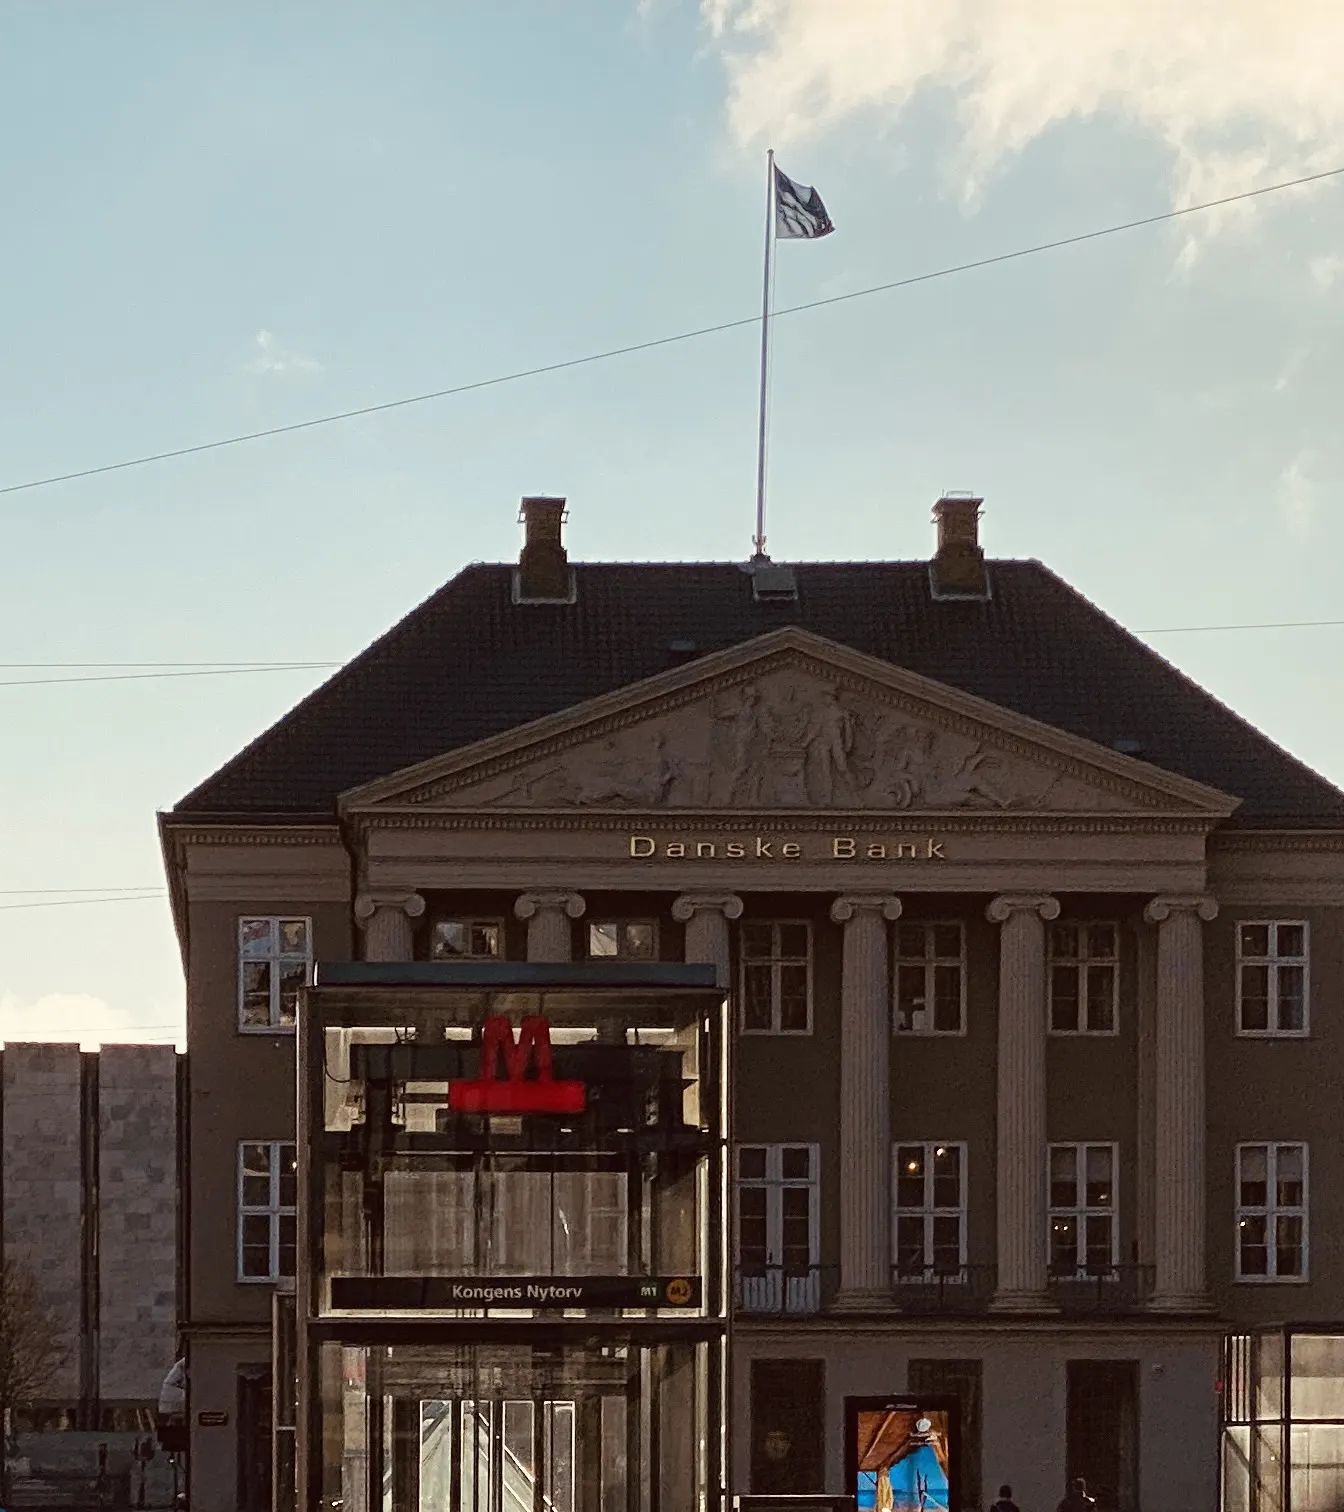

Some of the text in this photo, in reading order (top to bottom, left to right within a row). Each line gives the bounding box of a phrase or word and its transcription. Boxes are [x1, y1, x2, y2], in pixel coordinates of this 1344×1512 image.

[629, 836, 945, 859] Danske Bank
[481, 1012, 553, 1083] M
[452, 1285, 688, 1301] Kongens Nytorv M1 M2
